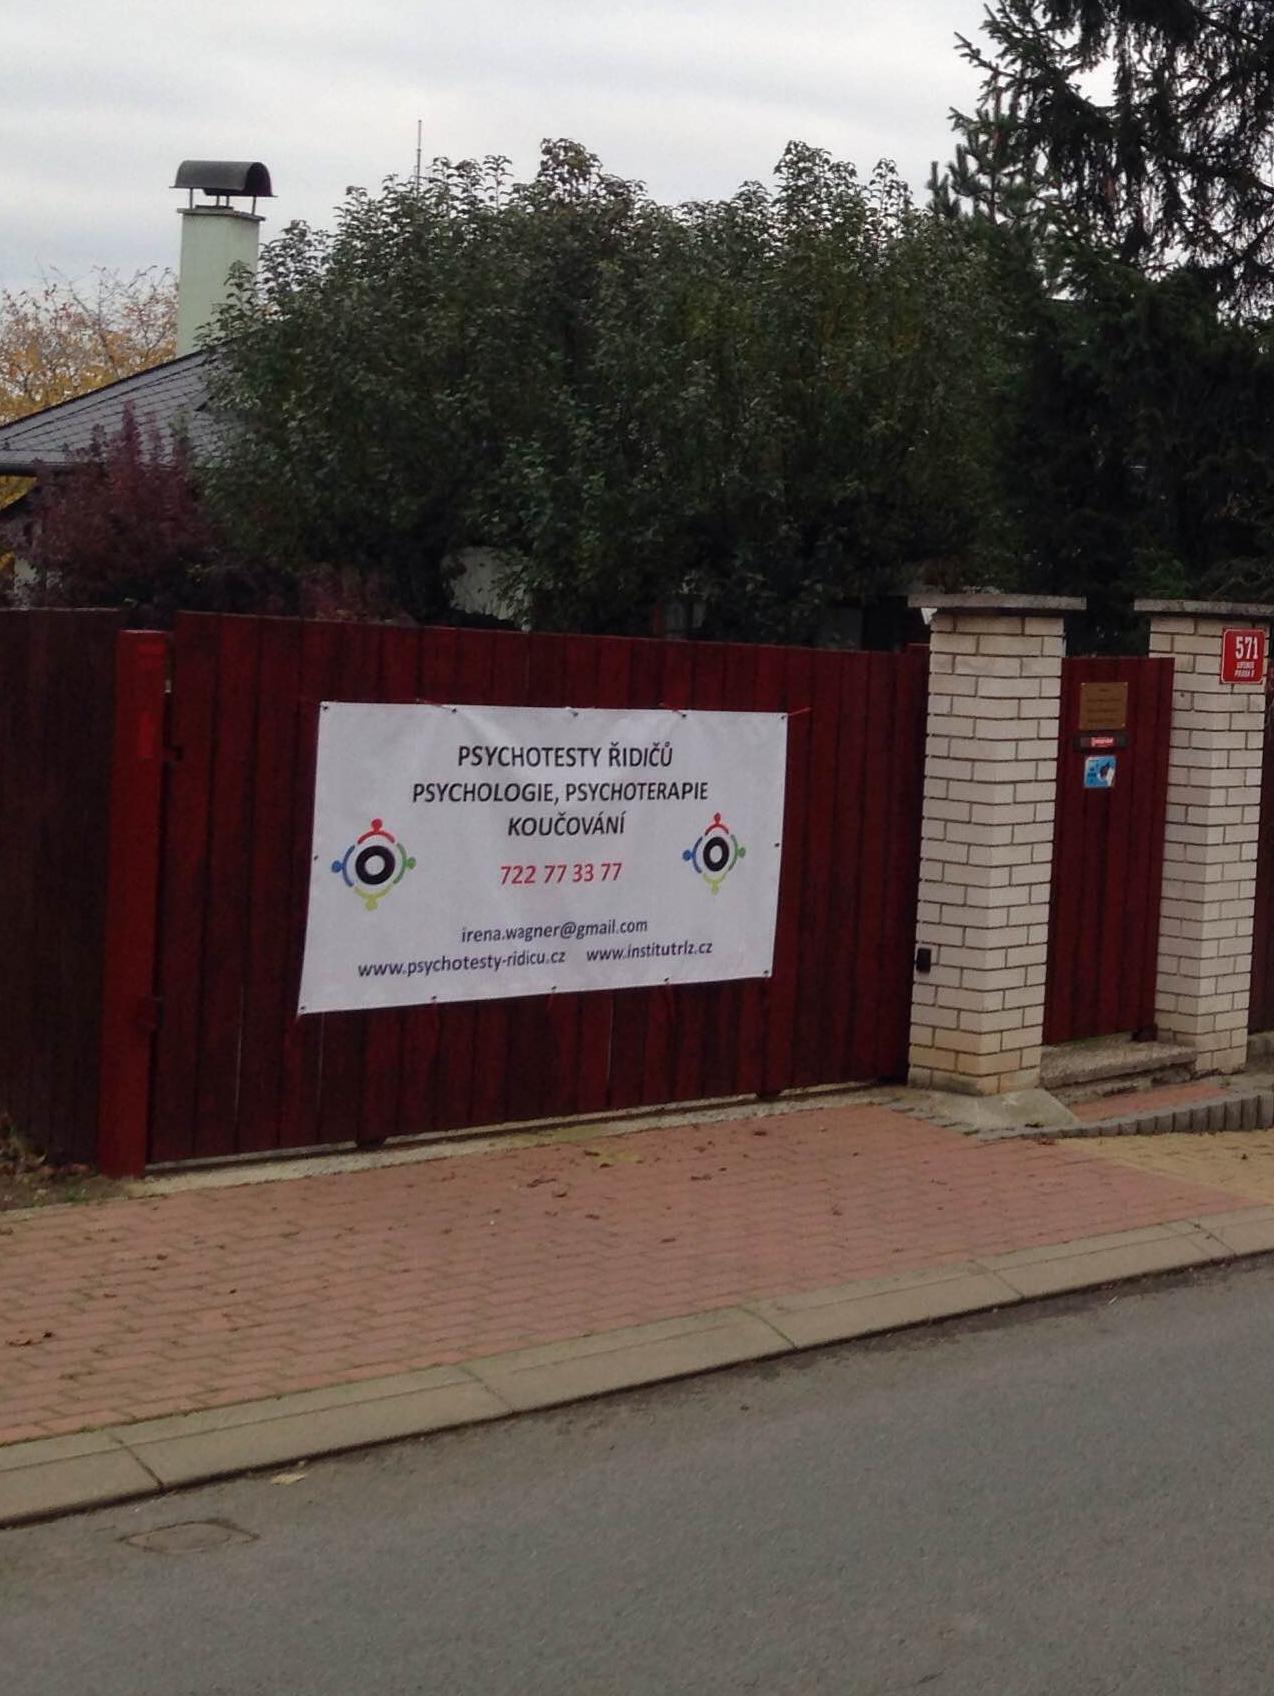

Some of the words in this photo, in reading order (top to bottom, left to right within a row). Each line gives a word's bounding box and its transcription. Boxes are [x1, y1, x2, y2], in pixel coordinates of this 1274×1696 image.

[1235, 636, 1259, 659] 571
[458, 746, 601, 767] PSYCHOTESTY
[609, 742, 673, 767] ŘIDIČŮ
[412, 783, 559, 805] PSYCHOLOGIE,
[566, 782, 709, 801] PSYCHOTERAPIE
[507, 811, 626, 836] KOUČOVÁNÍ
[500, 865, 536, 884] 722
[544, 865, 568, 884] 77
[573, 864, 594, 883] 33
[601, 863, 623, 882] 77
[461, 919, 648, 945] irena.wagner@gmail.com
[358, 950, 566, 977] www.psychotesty-ridicu.cz
[587, 941, 713, 962] www.institutrlz.cz
